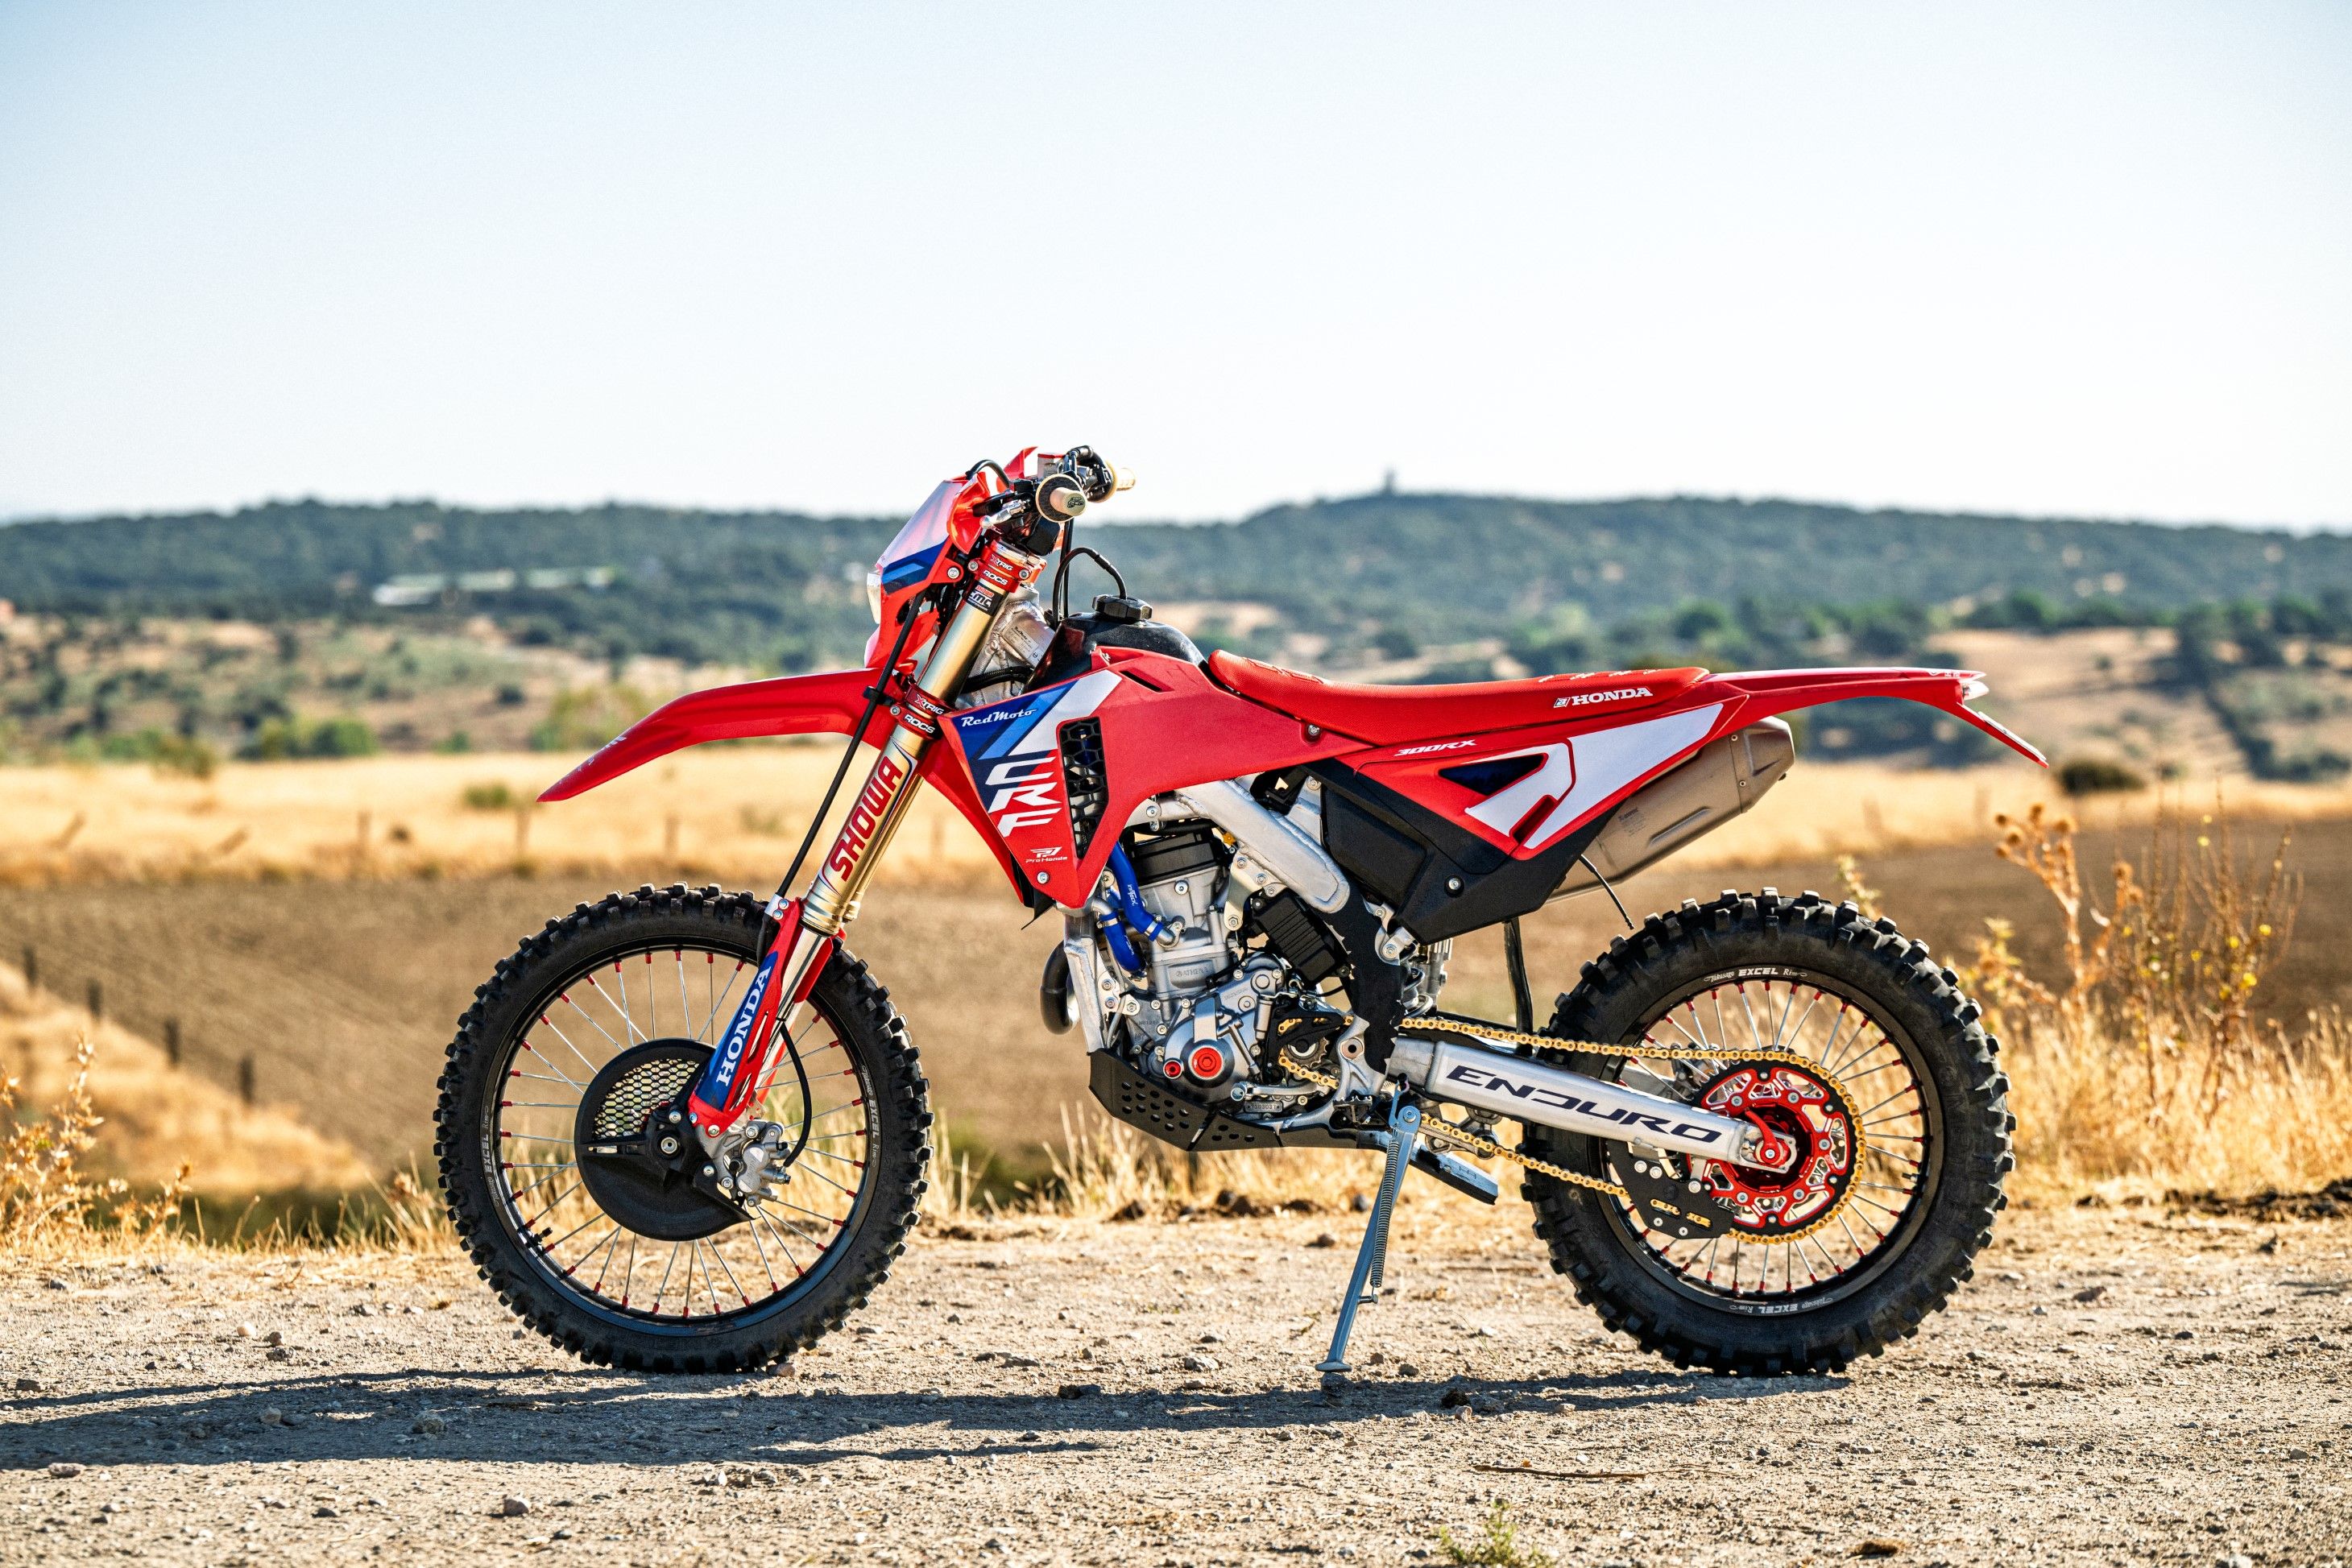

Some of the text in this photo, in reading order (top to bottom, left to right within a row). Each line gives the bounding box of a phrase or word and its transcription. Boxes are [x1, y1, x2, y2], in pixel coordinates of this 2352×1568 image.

[990, 553, 1013, 571] XTRIG
[983, 569, 1008, 585] ROCS
[913, 694, 944, 715] XTRIG
[1571, 687, 1653, 705] HONDA
[904, 714, 935, 734] ROCS
[961, 709, 1037, 727] RedMoto
[1393, 739, 1477, 757] 300RX
[985, 756, 1062, 838] CRF
[830, 755, 903, 882] SHOWA
[1738, 967, 1778, 977] EXCEL
[1783, 969, 1800, 977] Rim
[716, 966, 772, 1087] HONDA
[1446, 1065, 1722, 1144] ENDURO
[869, 1099, 880, 1139] EXCEL
[482, 1133, 493, 1173] EXCEL
[1734, 1305, 1754, 1314] Rim
[1758, 1304, 1798, 1314] EXCEL
